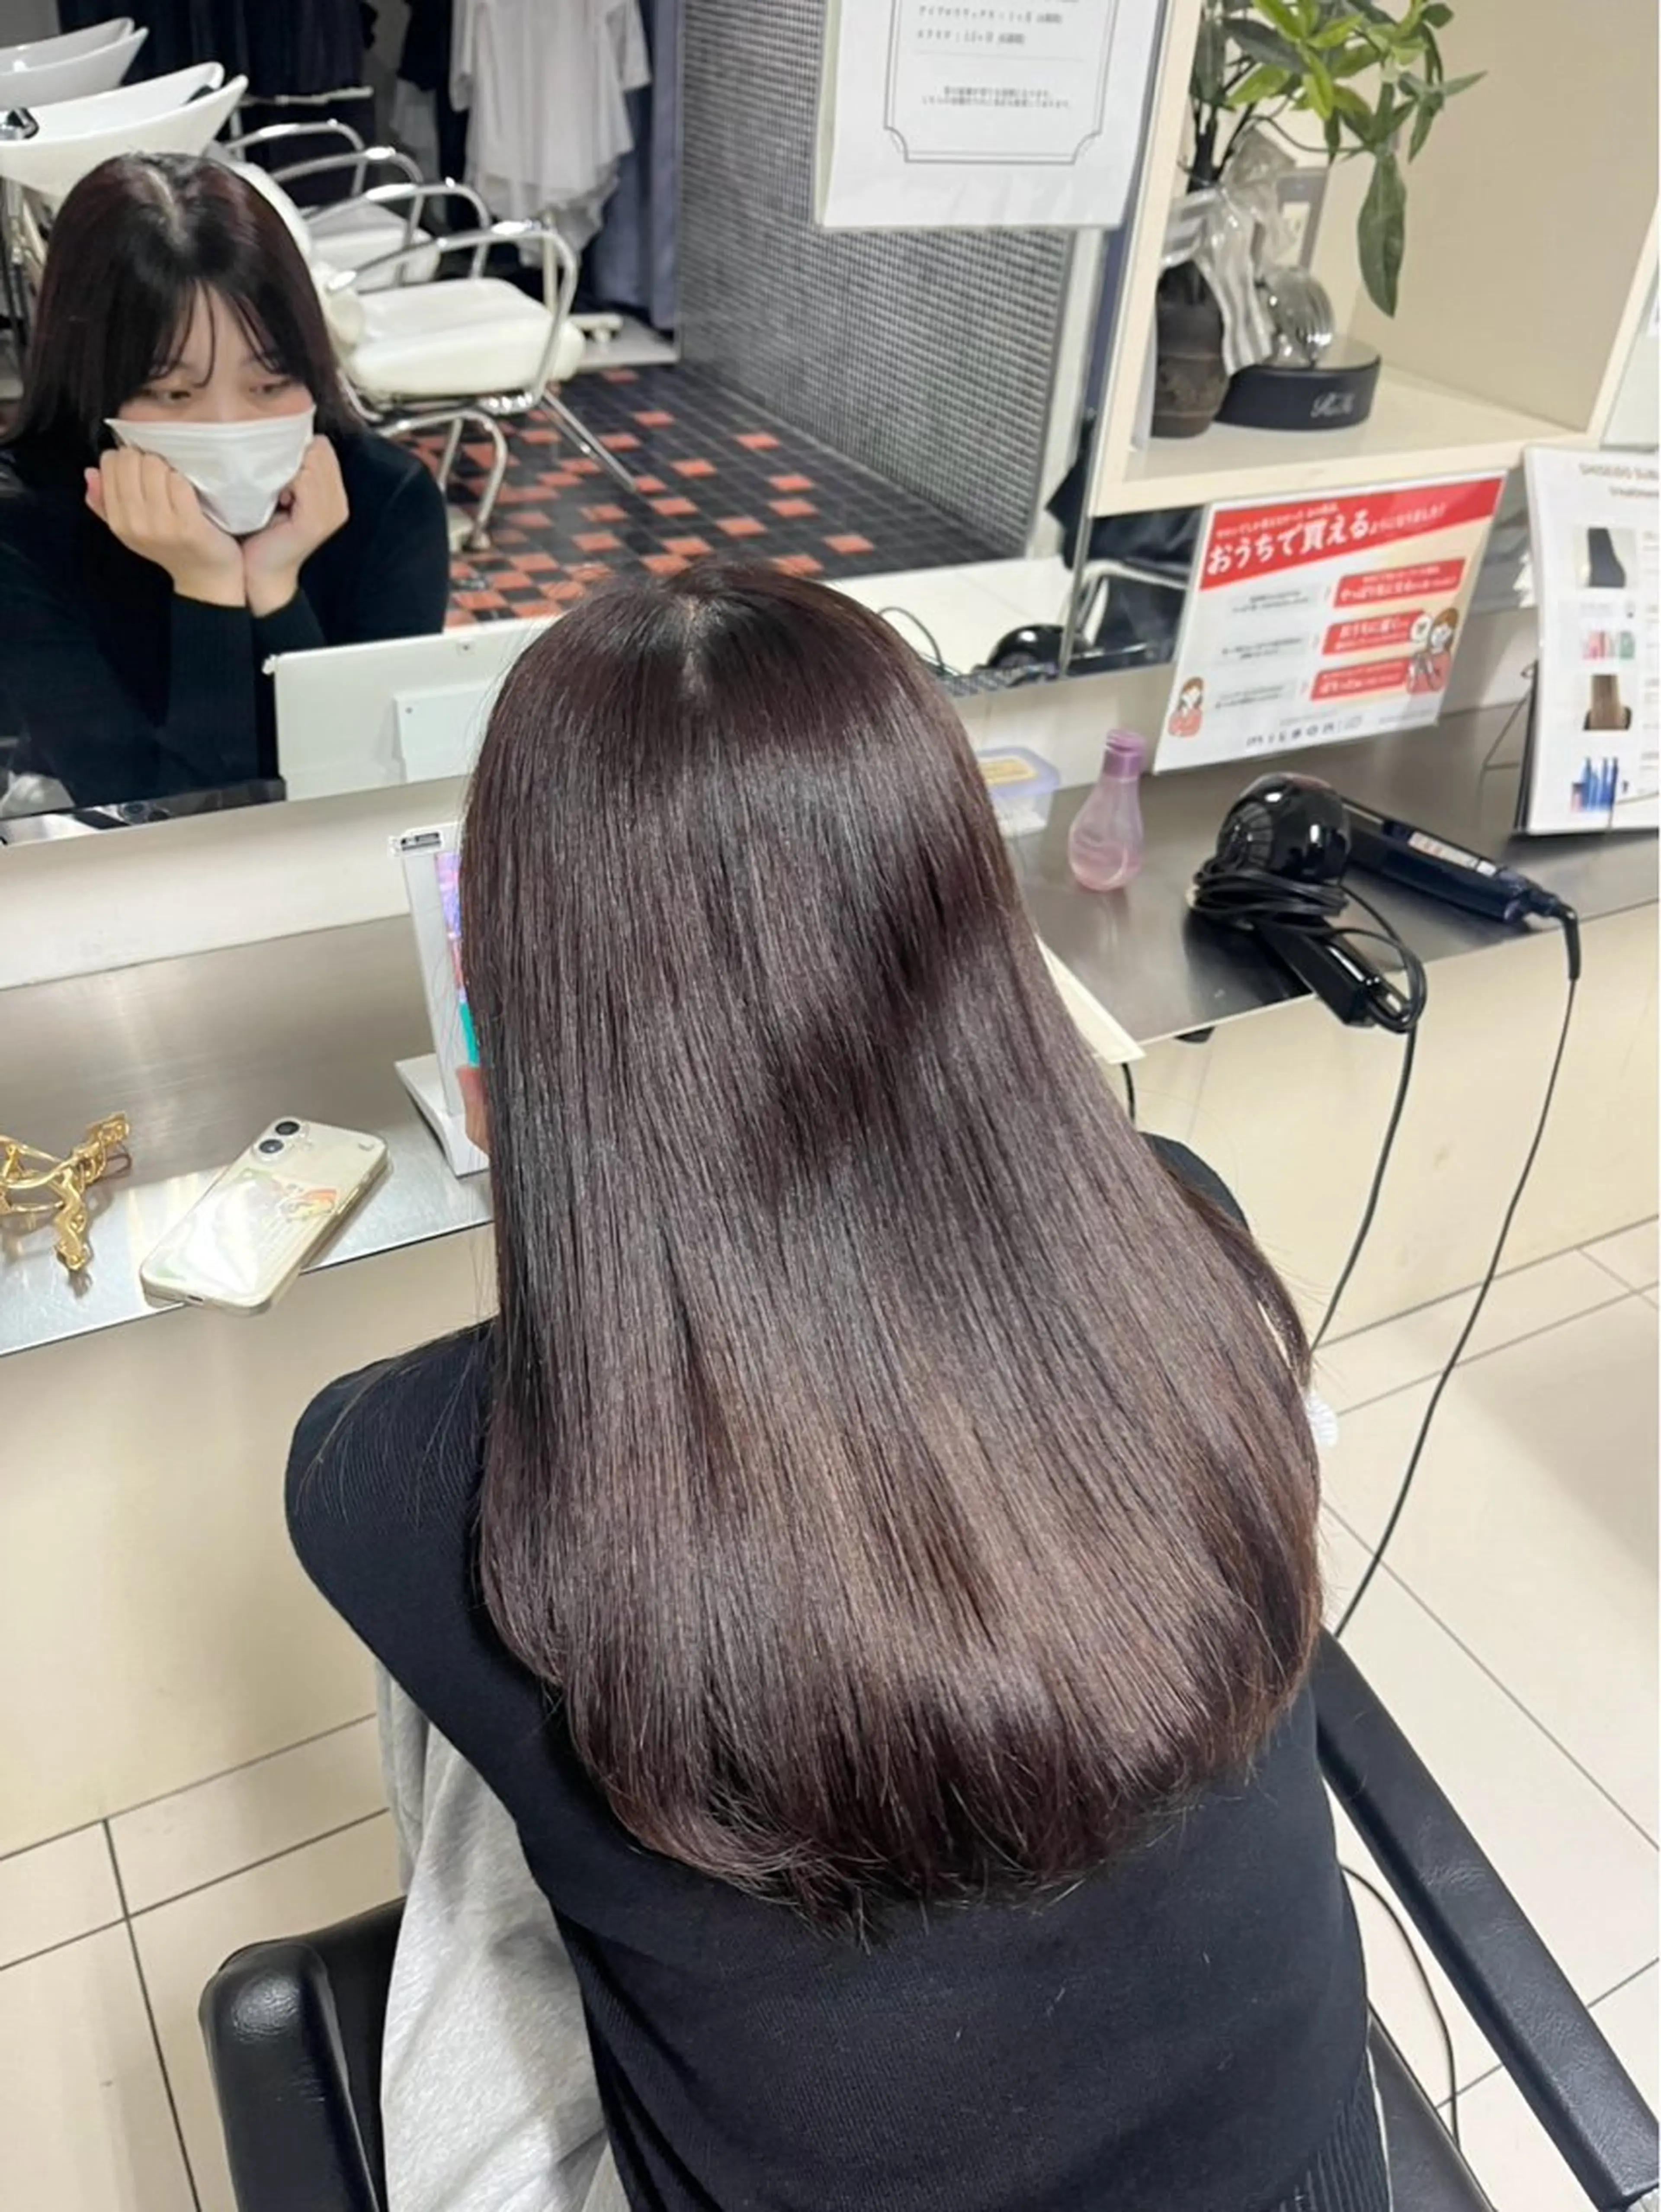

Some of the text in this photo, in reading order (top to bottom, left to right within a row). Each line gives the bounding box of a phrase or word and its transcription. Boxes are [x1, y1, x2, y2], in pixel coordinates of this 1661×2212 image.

[1206, 509, 1369, 575] おうちで買える
